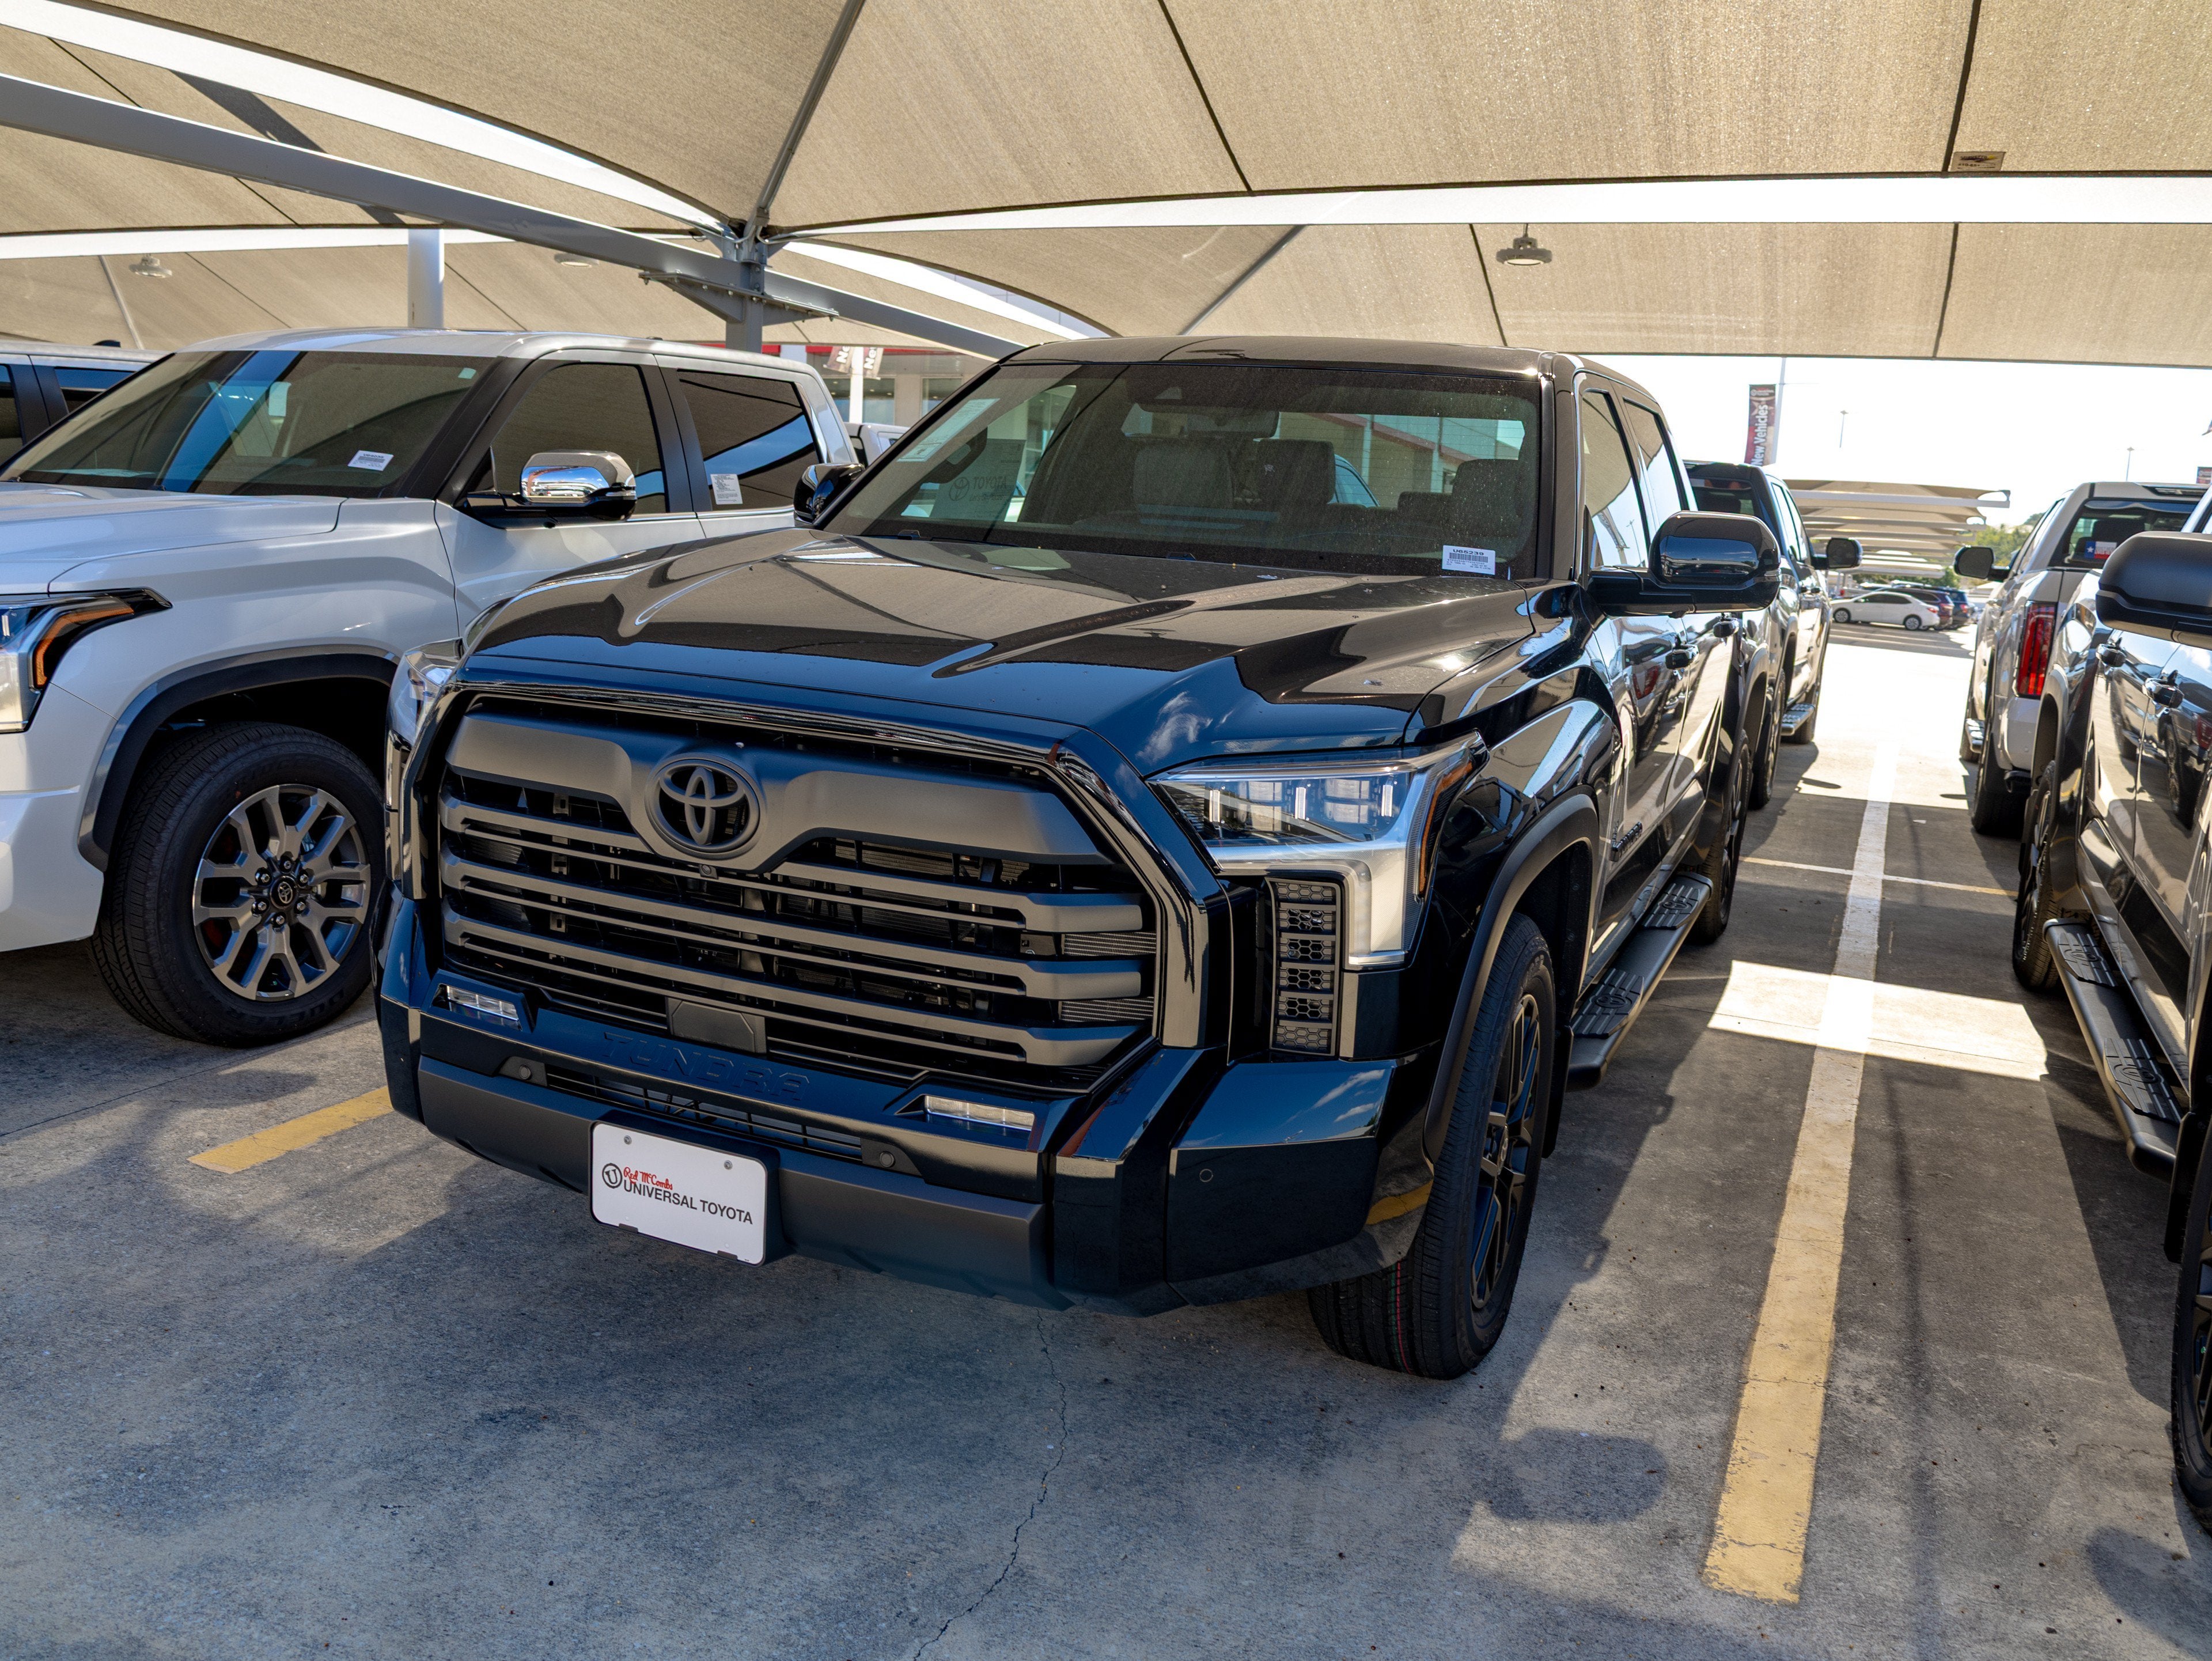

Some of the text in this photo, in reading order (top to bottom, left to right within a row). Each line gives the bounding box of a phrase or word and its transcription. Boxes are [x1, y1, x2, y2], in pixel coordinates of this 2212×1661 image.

[1753, 404, 1768, 444] Vehicles
[1751, 445, 1765, 466] New
[974, 476, 1007, 490] TOYOTA
[603, 1031, 810, 1101] TUNDRA
[623, 1167, 673, 1190] Red McCombs
[623, 1179, 753, 1224] UNIVERSAL TOYOTA
